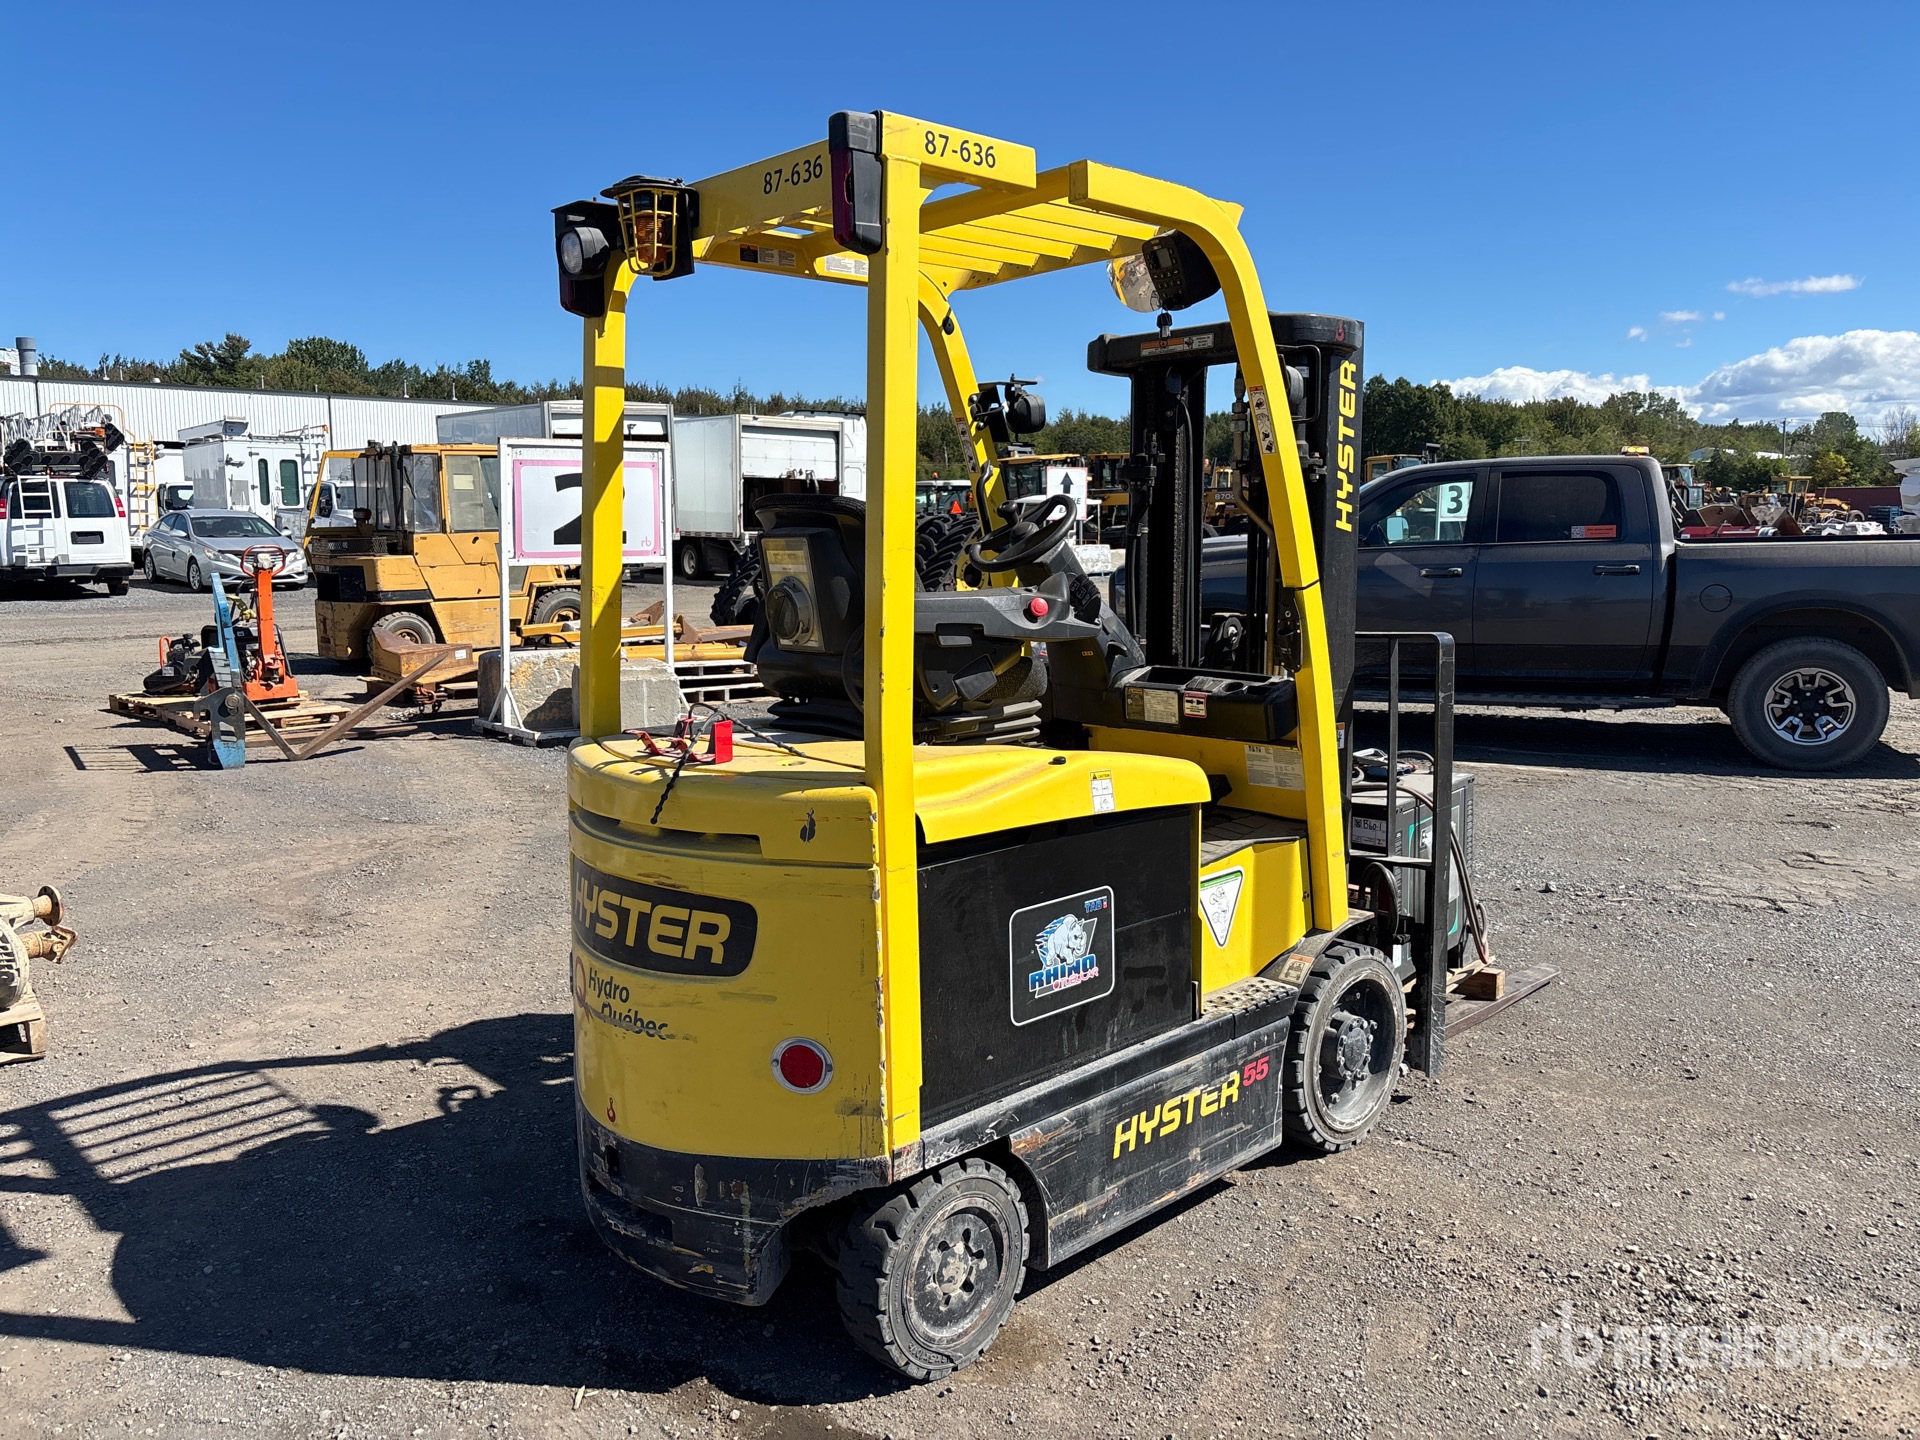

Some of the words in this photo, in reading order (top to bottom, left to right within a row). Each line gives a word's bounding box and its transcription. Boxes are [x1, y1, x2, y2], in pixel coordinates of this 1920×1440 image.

[925, 130, 996, 168] 87-636
[763, 154, 823, 195] 87-636
[1335, 360, 1357, 533] HYSTER
[1447, 485, 1463, 514] 3
[641, 536, 652, 547] rb
[574, 872, 731, 965] HYSTER
[588, 967, 629, 1003] Hydro
[1029, 954, 1096, 992] RHINO
[601, 1001, 668, 1040] Québec
[1112, 1070, 1241, 1160] HYSTER
[1242, 1055, 1270, 1087] 55
